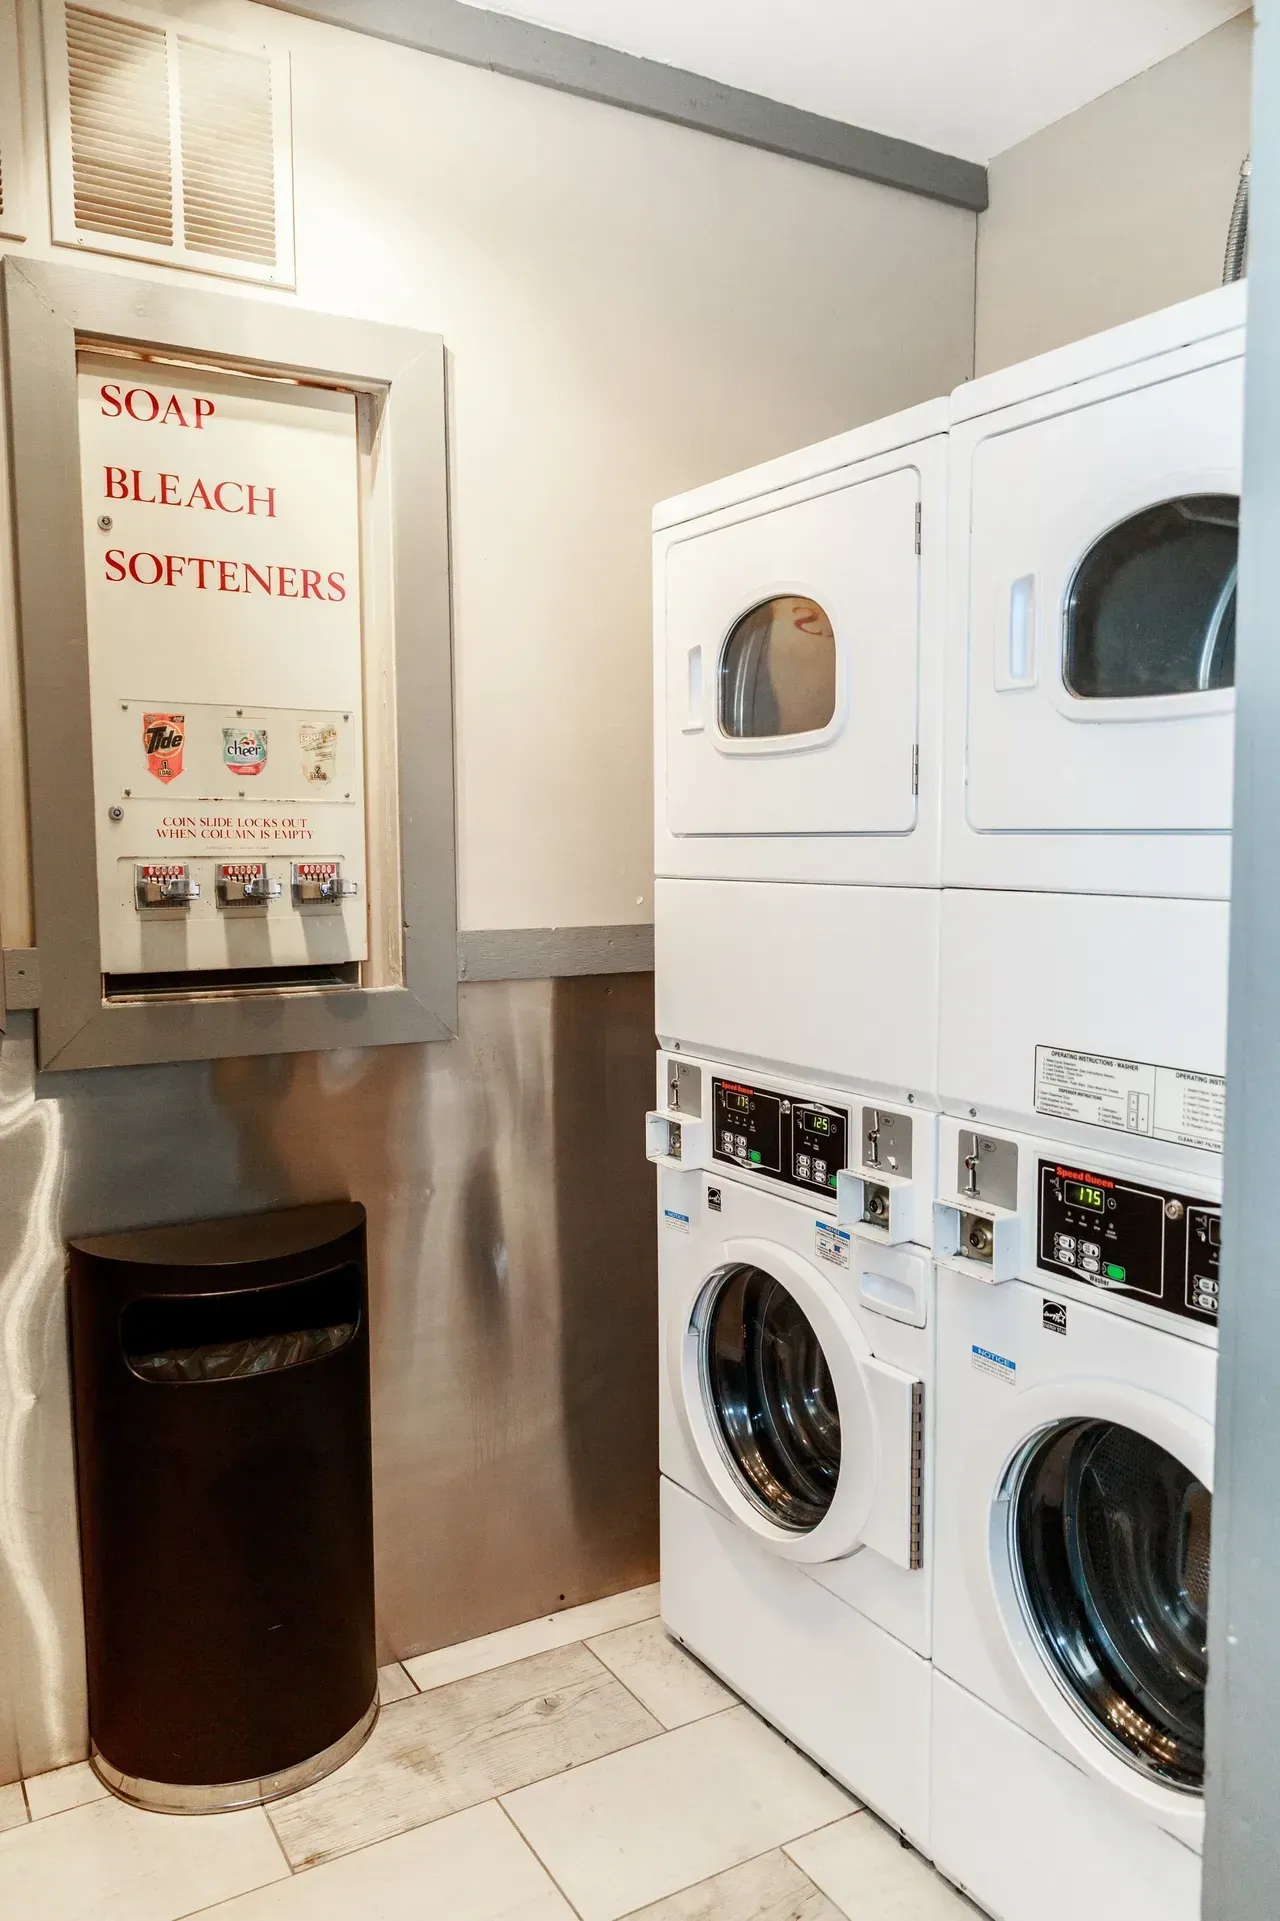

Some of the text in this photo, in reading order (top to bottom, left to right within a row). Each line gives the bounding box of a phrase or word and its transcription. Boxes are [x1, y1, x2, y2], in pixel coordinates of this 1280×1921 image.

[100, 384, 215, 429] SOAP
[103, 466, 277, 517] BLEACH
[104, 549, 346, 602] SOFTENERS
[146, 726, 183, 754] Tide
[227, 740, 261, 757] cheer
[163, 817, 307, 828] COIN SLIDE LOCKS OUT
[156, 829, 313, 840] WHEN COLUMN IS EMPTY
[1051, 1050, 1078, 1061] OPERATING
[1078, 1054, 1113, 1067] INSTRUCTIONS
[1117, 1062, 1139, 1071] WASHER
[721, 1081, 737, 1090] Speed
[1175, 1072, 1208, 1084] OPERATING
[813, 1116, 828, 1130] 125
[1178, 1135, 1193, 1143] CLEAN
[1205, 1141, 1221, 1149] FILTER
[1056, 1166, 1114, 1188] Speed Queen
[1079, 1187, 1100, 1205] 175
[1089, 1274, 1109, 1286] Washer
[977, 1348, 1010, 1366] NOTICE
